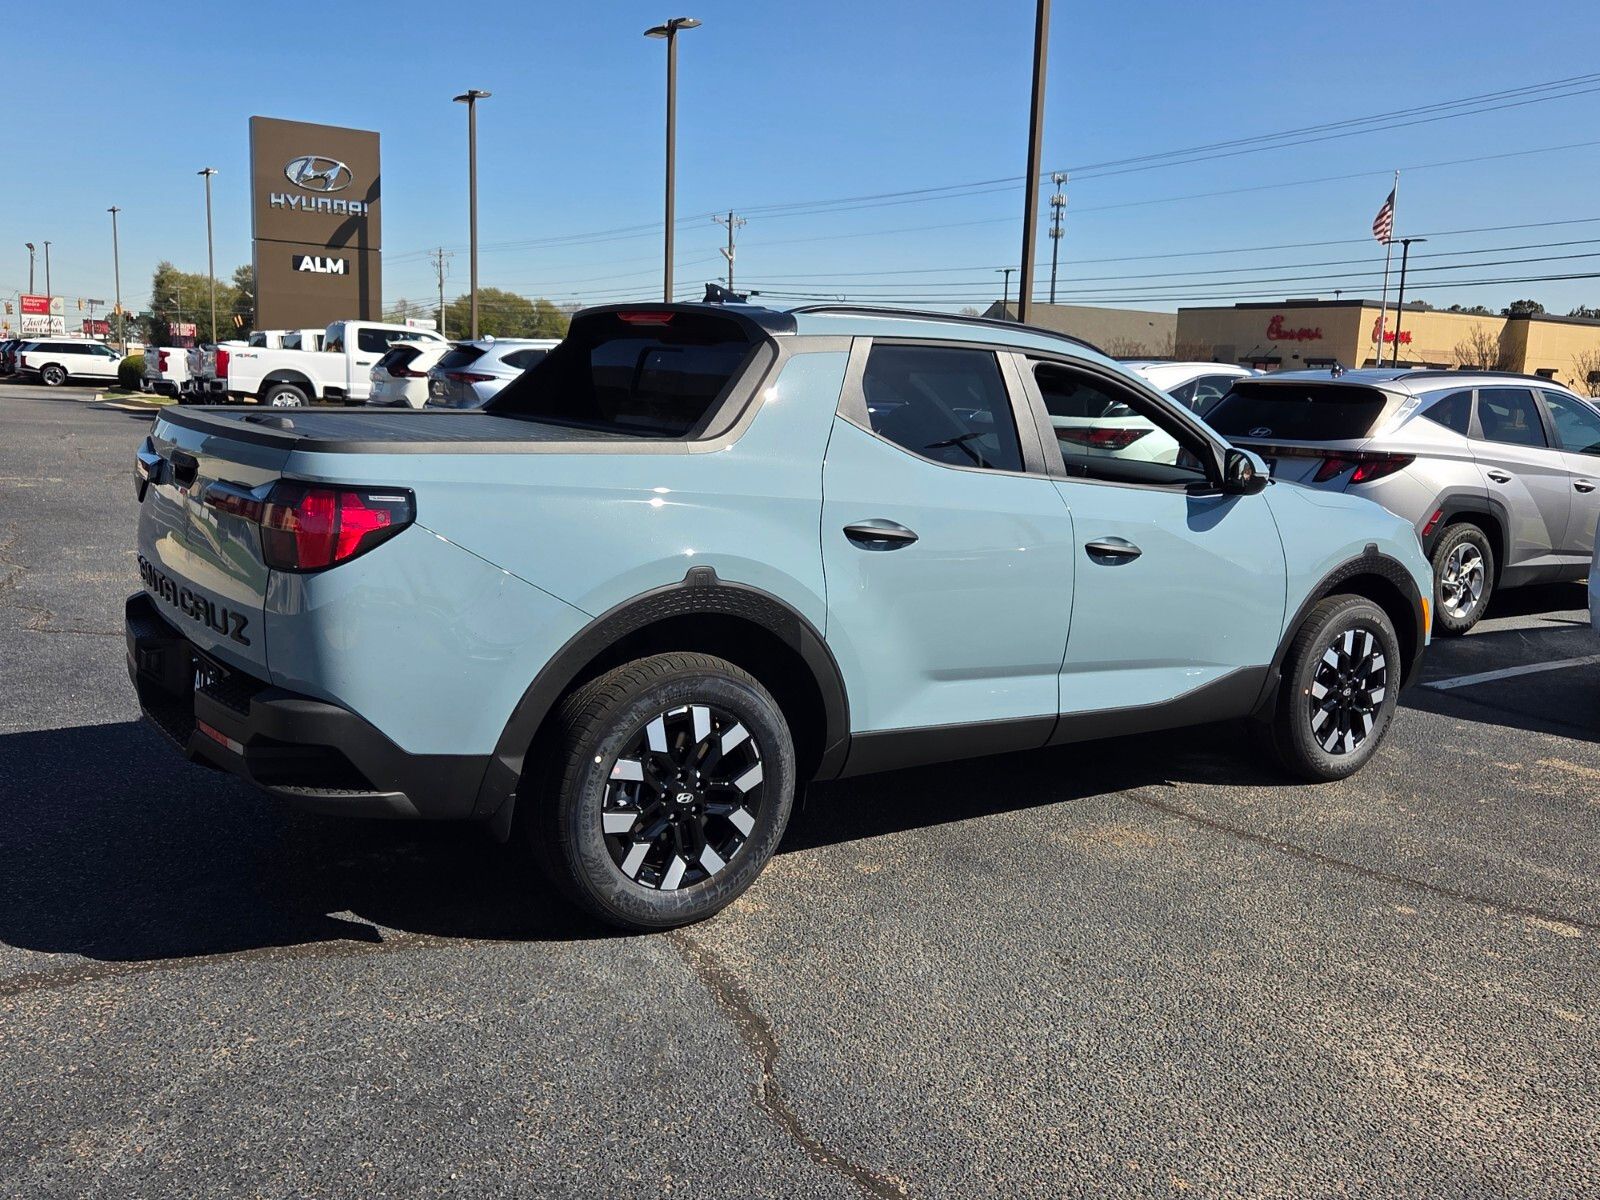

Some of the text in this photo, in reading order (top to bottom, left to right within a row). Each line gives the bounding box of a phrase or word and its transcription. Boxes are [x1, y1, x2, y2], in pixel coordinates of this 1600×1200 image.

[270, 192, 368, 217] HYUNDAI
[299, 255, 344, 275] ALM
[179, 587, 250, 647] CRUZ
